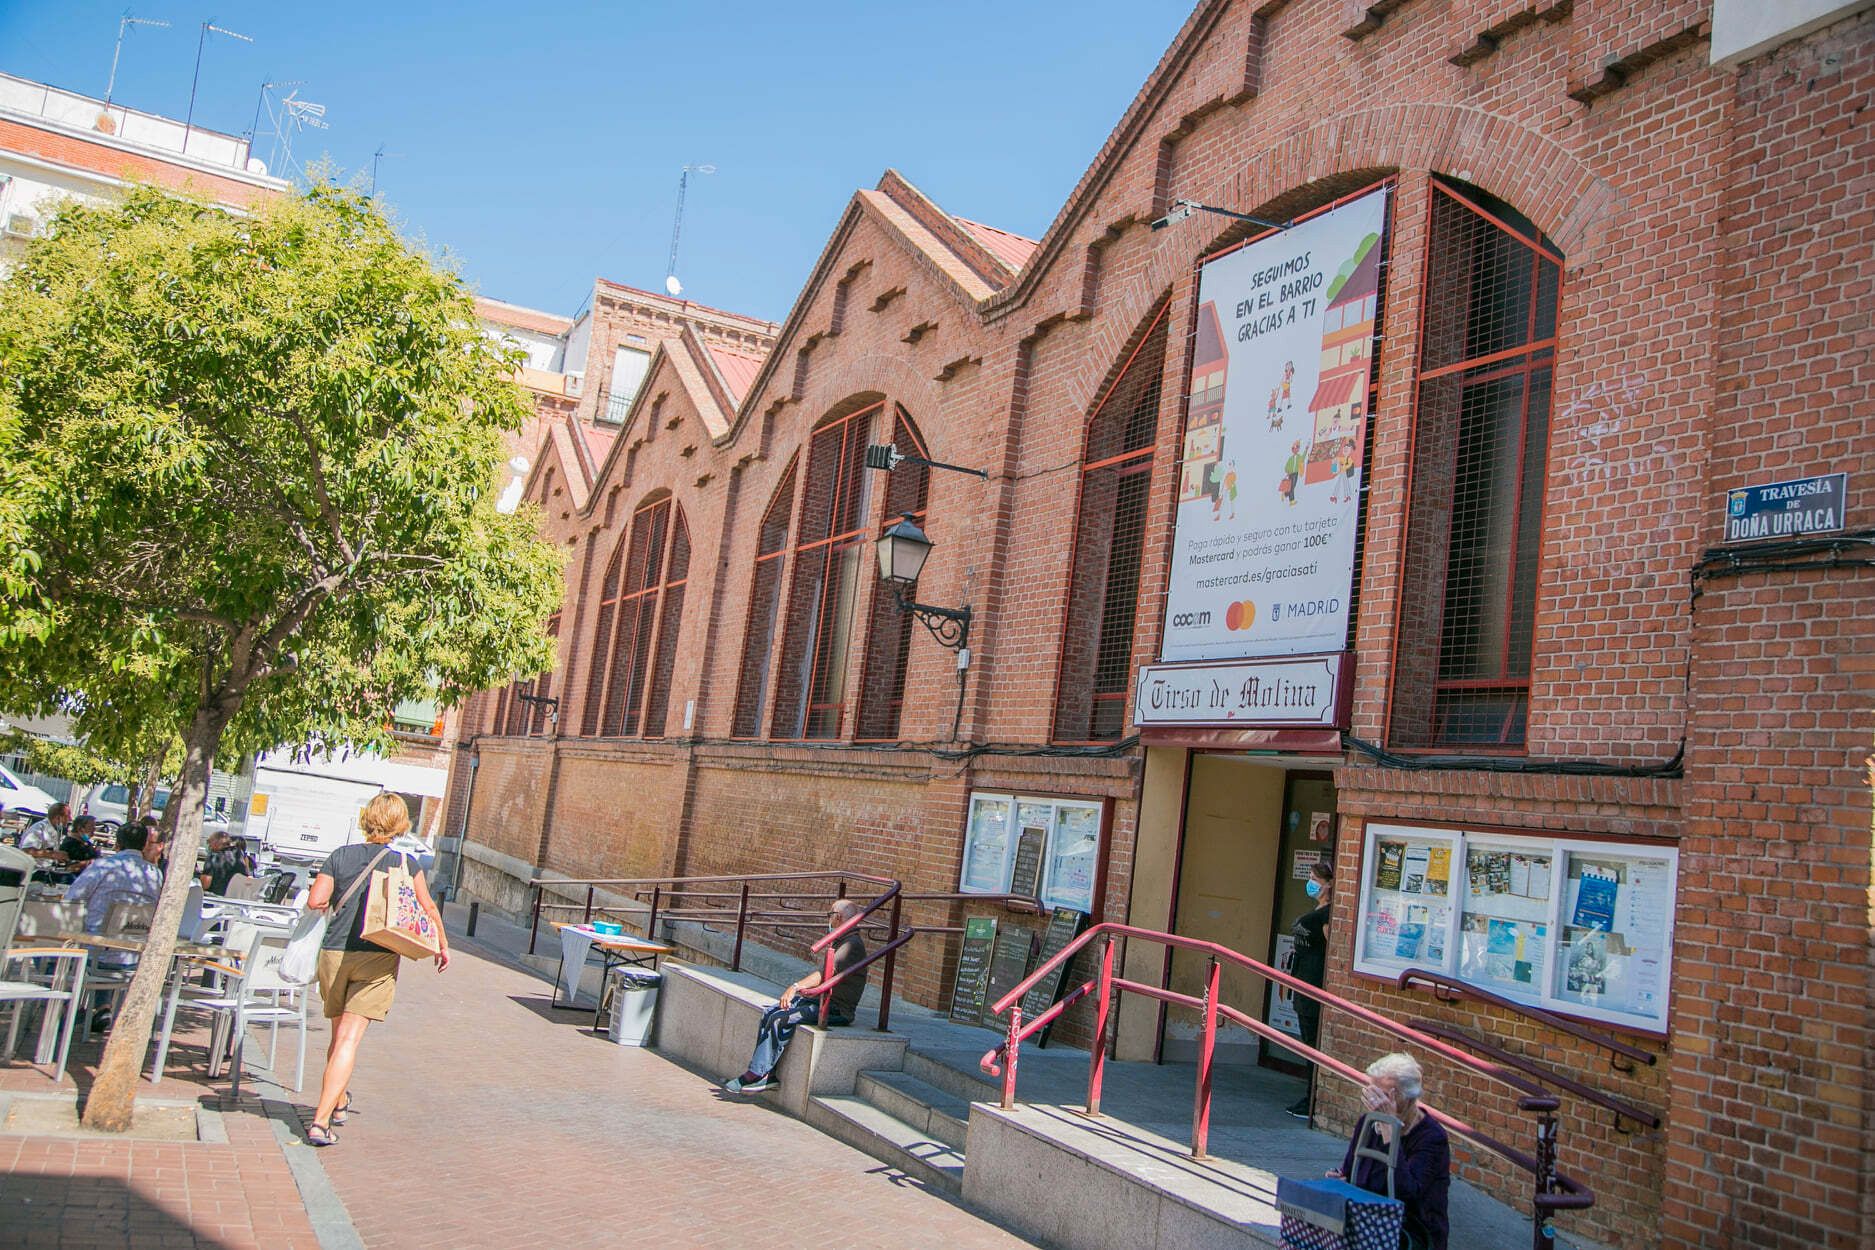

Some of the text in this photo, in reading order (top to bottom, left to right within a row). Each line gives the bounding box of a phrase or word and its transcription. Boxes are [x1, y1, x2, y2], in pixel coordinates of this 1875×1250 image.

[1250, 251, 1312, 291] SEGUIMOS
[1235, 271, 1323, 319] EN EL BARRIO
[1238, 297, 1316, 343] GRACIAS A TI
[1760, 480, 1832, 501] TRAVESÍA
[1786, 501, 1800, 509] DE
[1188, 539, 1208, 552] Paga
[1236, 536, 1242, 547] y
[1243, 529, 1272, 543] seguro
[1273, 526, 1290, 537] con
[1292, 522, 1303, 533] tu
[1304, 516, 1338, 532] tarjeta
[1731, 507, 1835, 540] DOÑA URRACA
[1189, 548, 1235, 566] Mastercard
[1274, 541, 1302, 556] ganar
[1196, 560, 1318, 589] mastercard.es/graciasati
[1287, 598, 1340, 618] MADRID
[1151, 675, 1317, 710] Tirso de Molina
